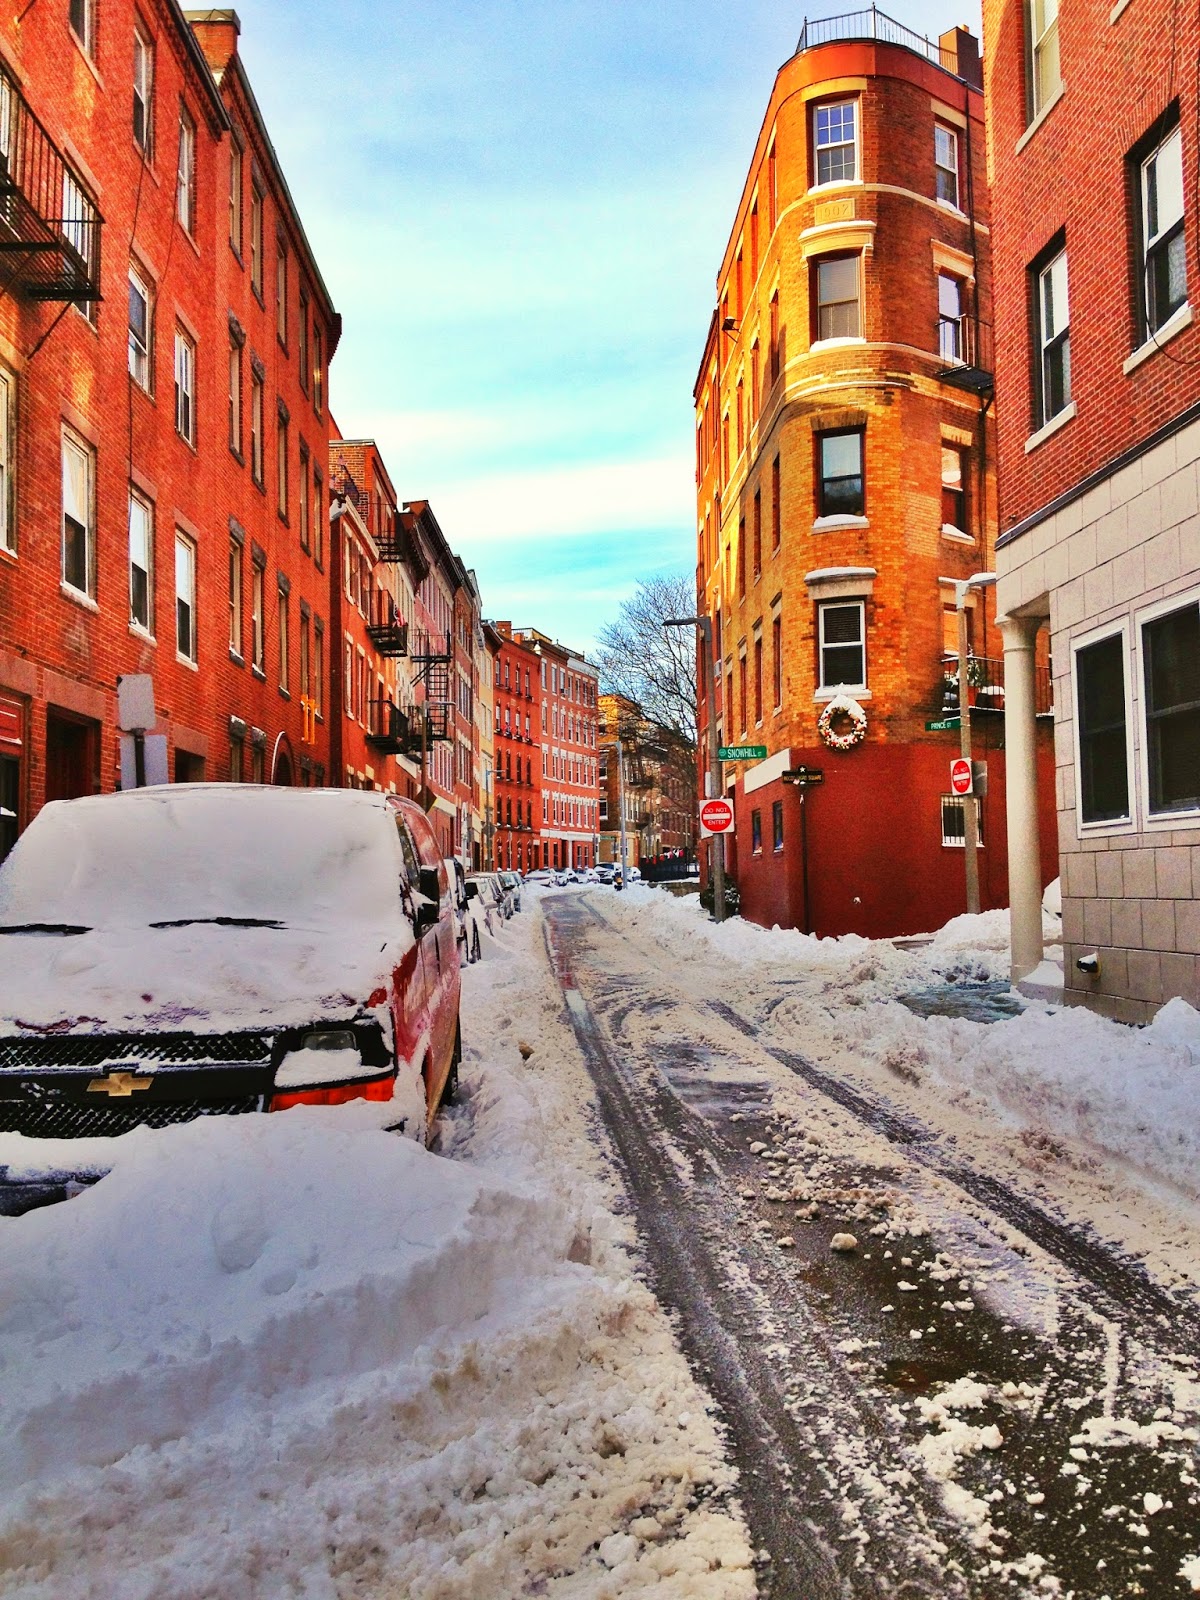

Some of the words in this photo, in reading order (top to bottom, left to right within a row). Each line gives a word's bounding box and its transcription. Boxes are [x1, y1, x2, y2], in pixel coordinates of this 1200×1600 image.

[819, 203, 849, 220] 1907
[930, 722, 946, 730] PRINCE
[727, 748, 757, 758] SNOWHILL
